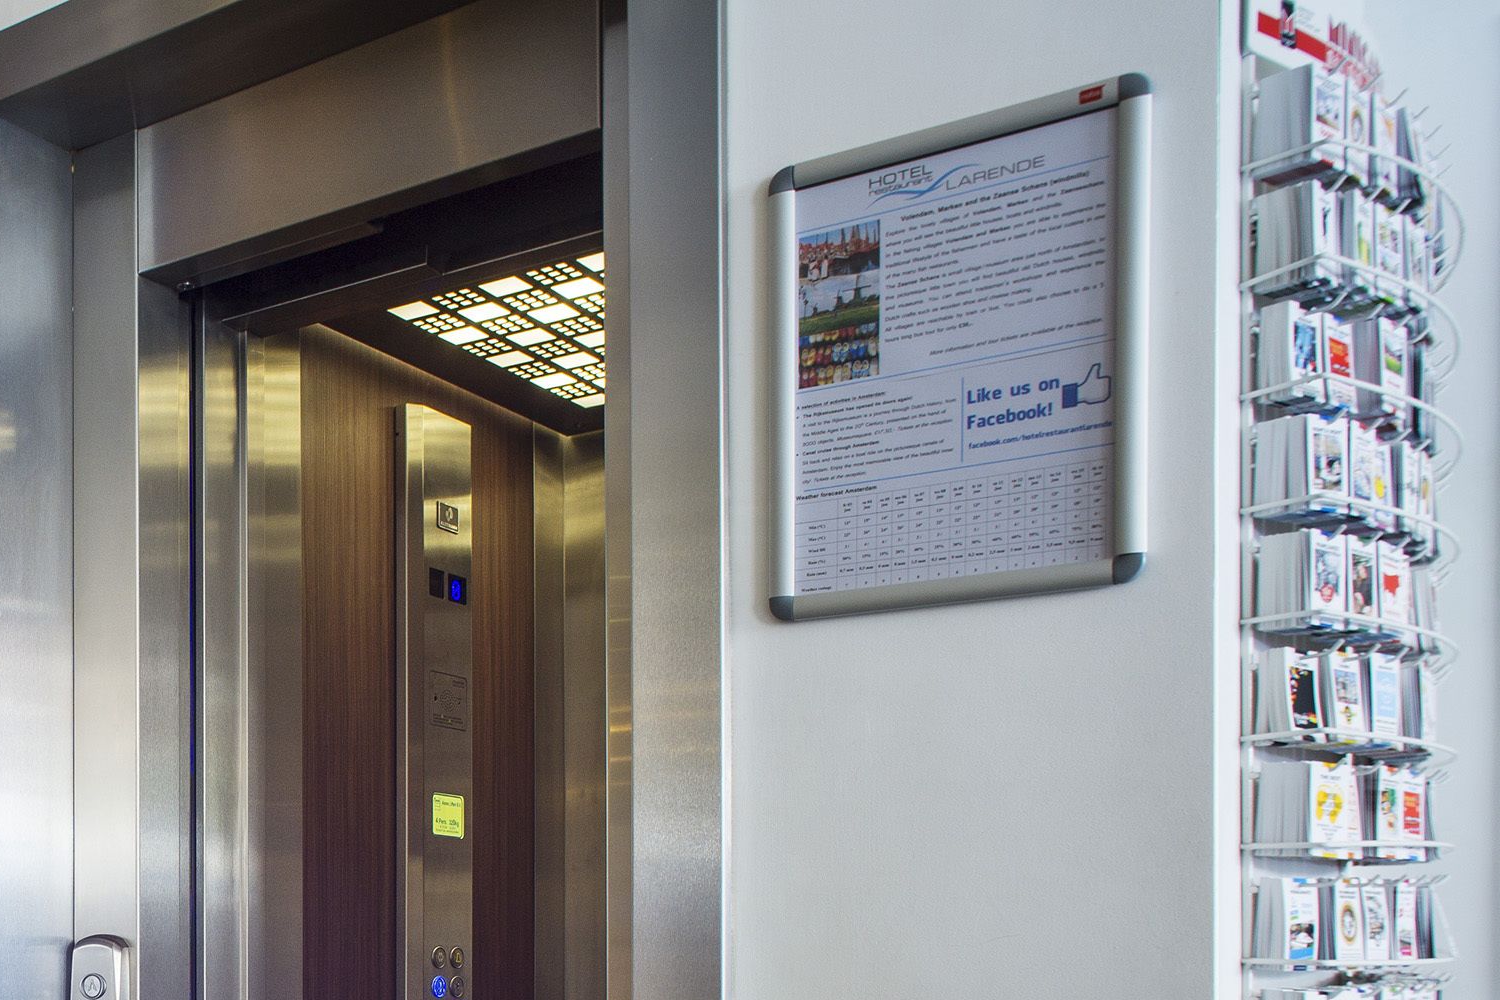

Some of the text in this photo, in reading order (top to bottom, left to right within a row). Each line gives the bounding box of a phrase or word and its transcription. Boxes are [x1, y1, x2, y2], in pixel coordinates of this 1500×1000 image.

[868, 164, 932, 188] HOTEL
[946, 155, 1045, 190] LARENDE
[967, 378, 1060, 404] Like us on
[967, 402, 1053, 430] Facebook!
